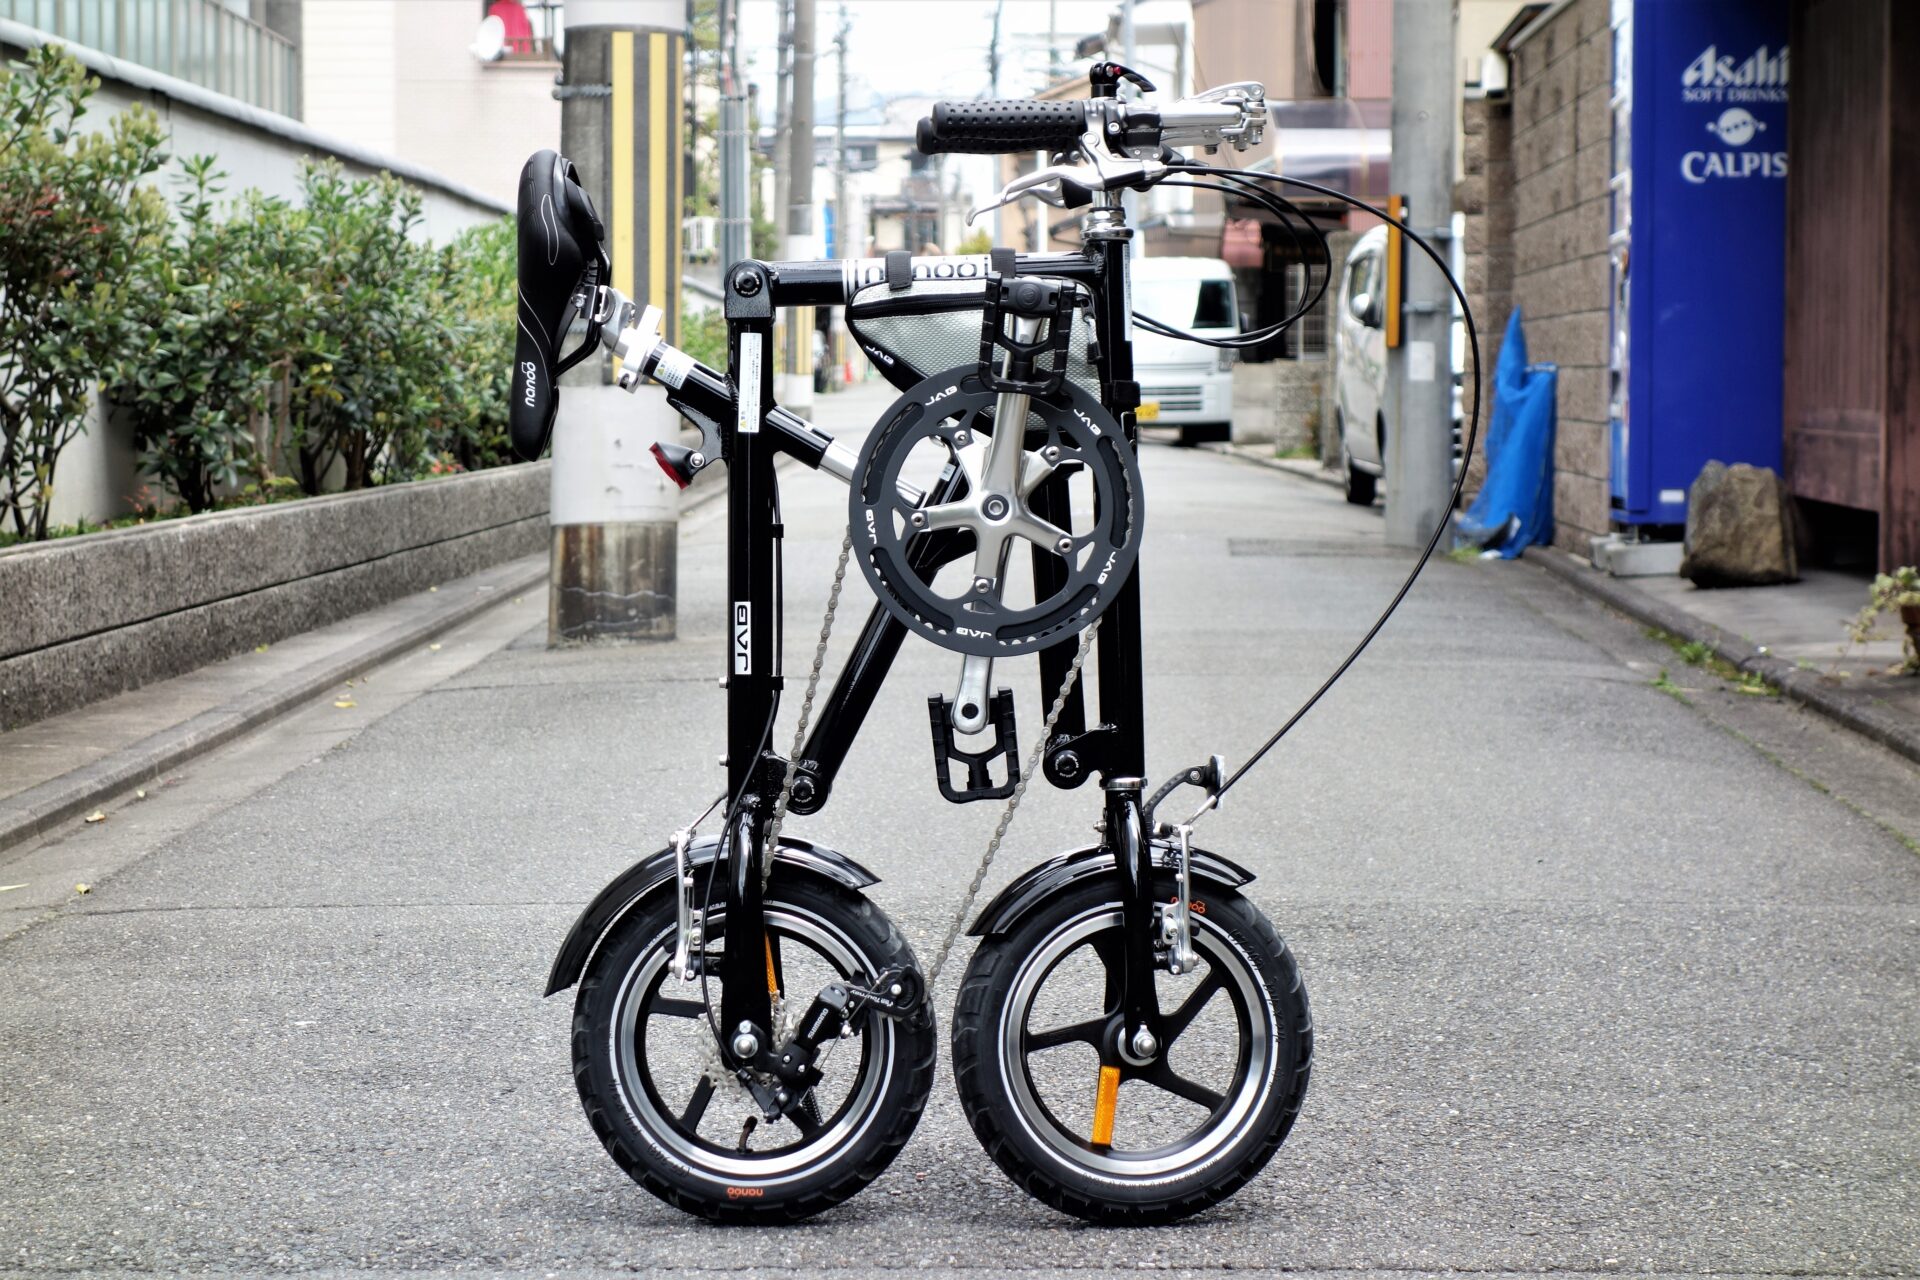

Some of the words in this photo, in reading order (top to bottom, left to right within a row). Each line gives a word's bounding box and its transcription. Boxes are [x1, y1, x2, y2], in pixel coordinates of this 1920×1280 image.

[1682, 45, 1789, 87] Asahi
[1683, 87, 1725, 102] SOFT
[1681, 151, 1788, 184] CALPIS
[866, 345, 894, 365] JAB
[523, 361, 536, 407] nanoo
[925, 385, 958, 406] JAB
[1073, 408, 1101, 436] JAB
[866, 509, 877, 544] JAB
[1097, 552, 1116, 584] JAB
[737, 605, 748, 671] JAB
[956, 627, 992, 639] JAB
[727, 1187, 764, 1198] nanoo
